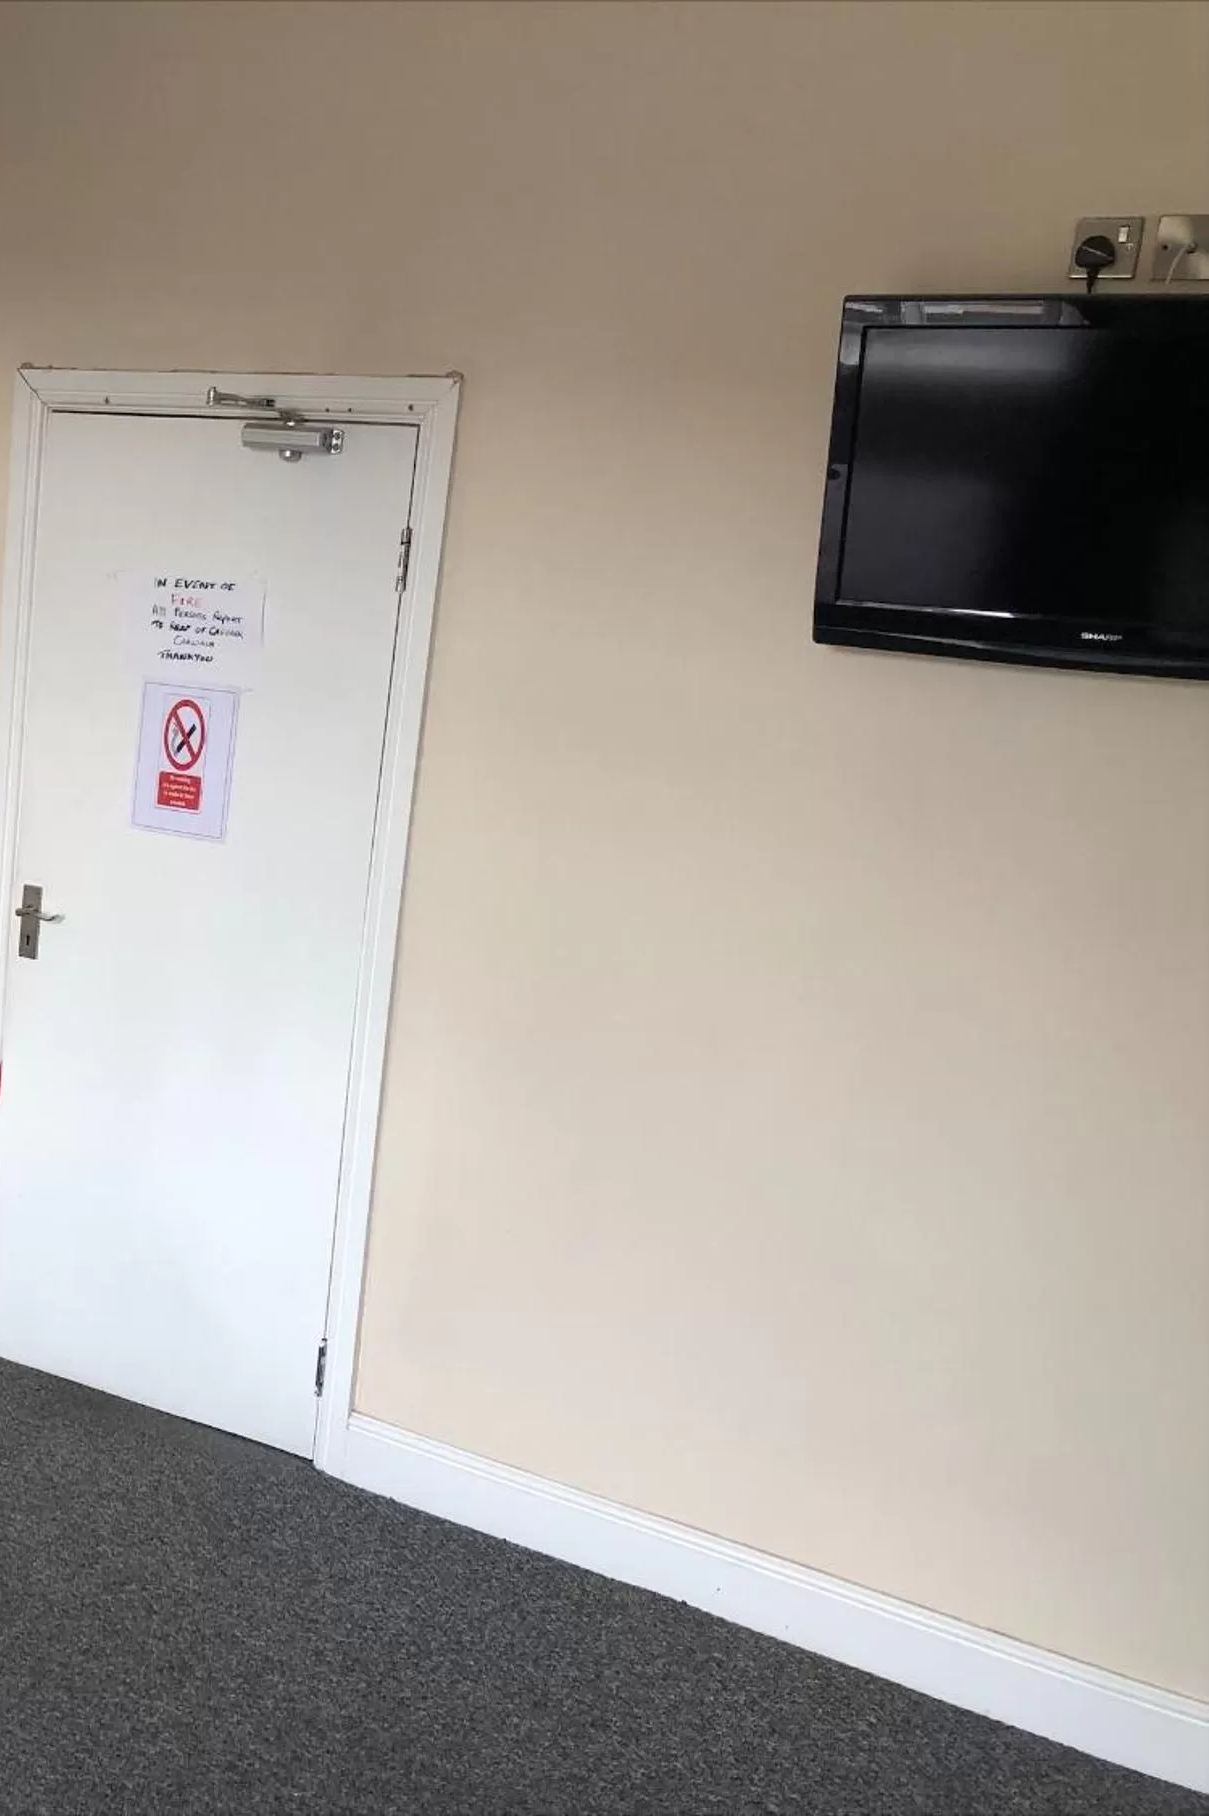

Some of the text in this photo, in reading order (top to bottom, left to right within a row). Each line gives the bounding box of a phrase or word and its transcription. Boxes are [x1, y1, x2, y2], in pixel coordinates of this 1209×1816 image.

[154, 578, 167, 588] IN
[174, 578, 217, 590] EVENT
[171, 592, 203, 607] FIRE
[1081, 632, 1122, 641] SHARP
